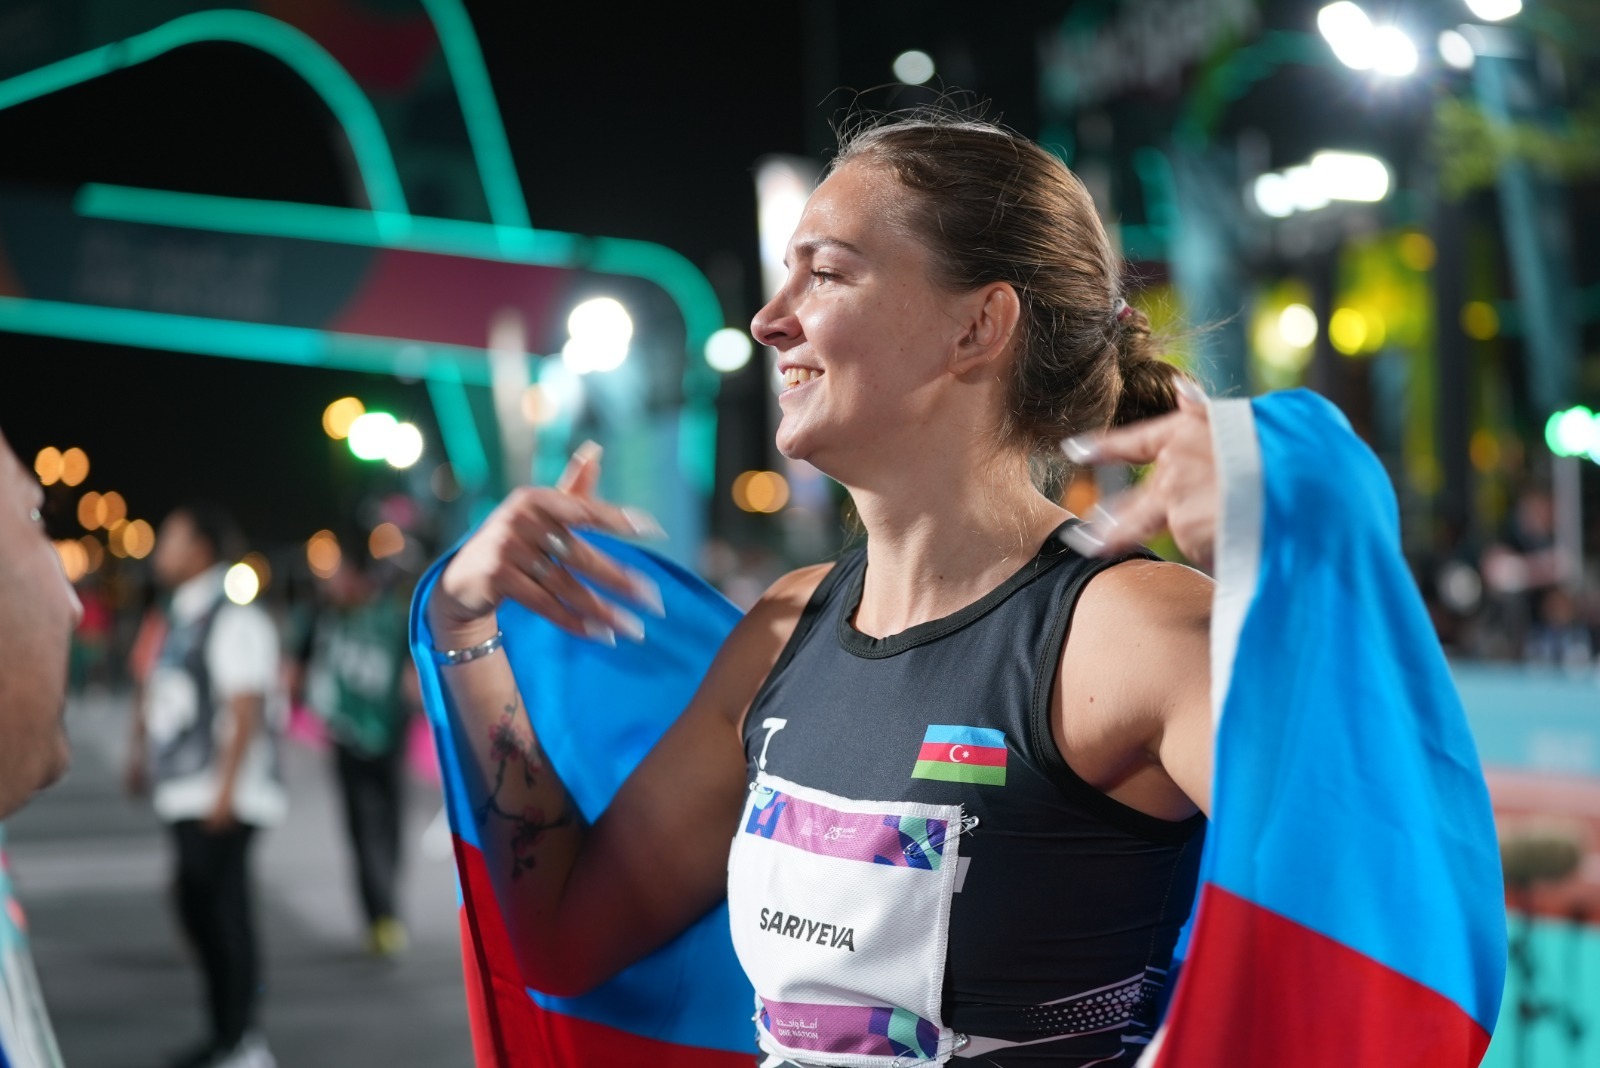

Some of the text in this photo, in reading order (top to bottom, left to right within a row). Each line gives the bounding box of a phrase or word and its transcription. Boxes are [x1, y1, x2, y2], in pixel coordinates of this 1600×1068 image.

[760, 907, 855, 952] SARIYEVA
[778, 1028, 818, 1039] ONE NATION
